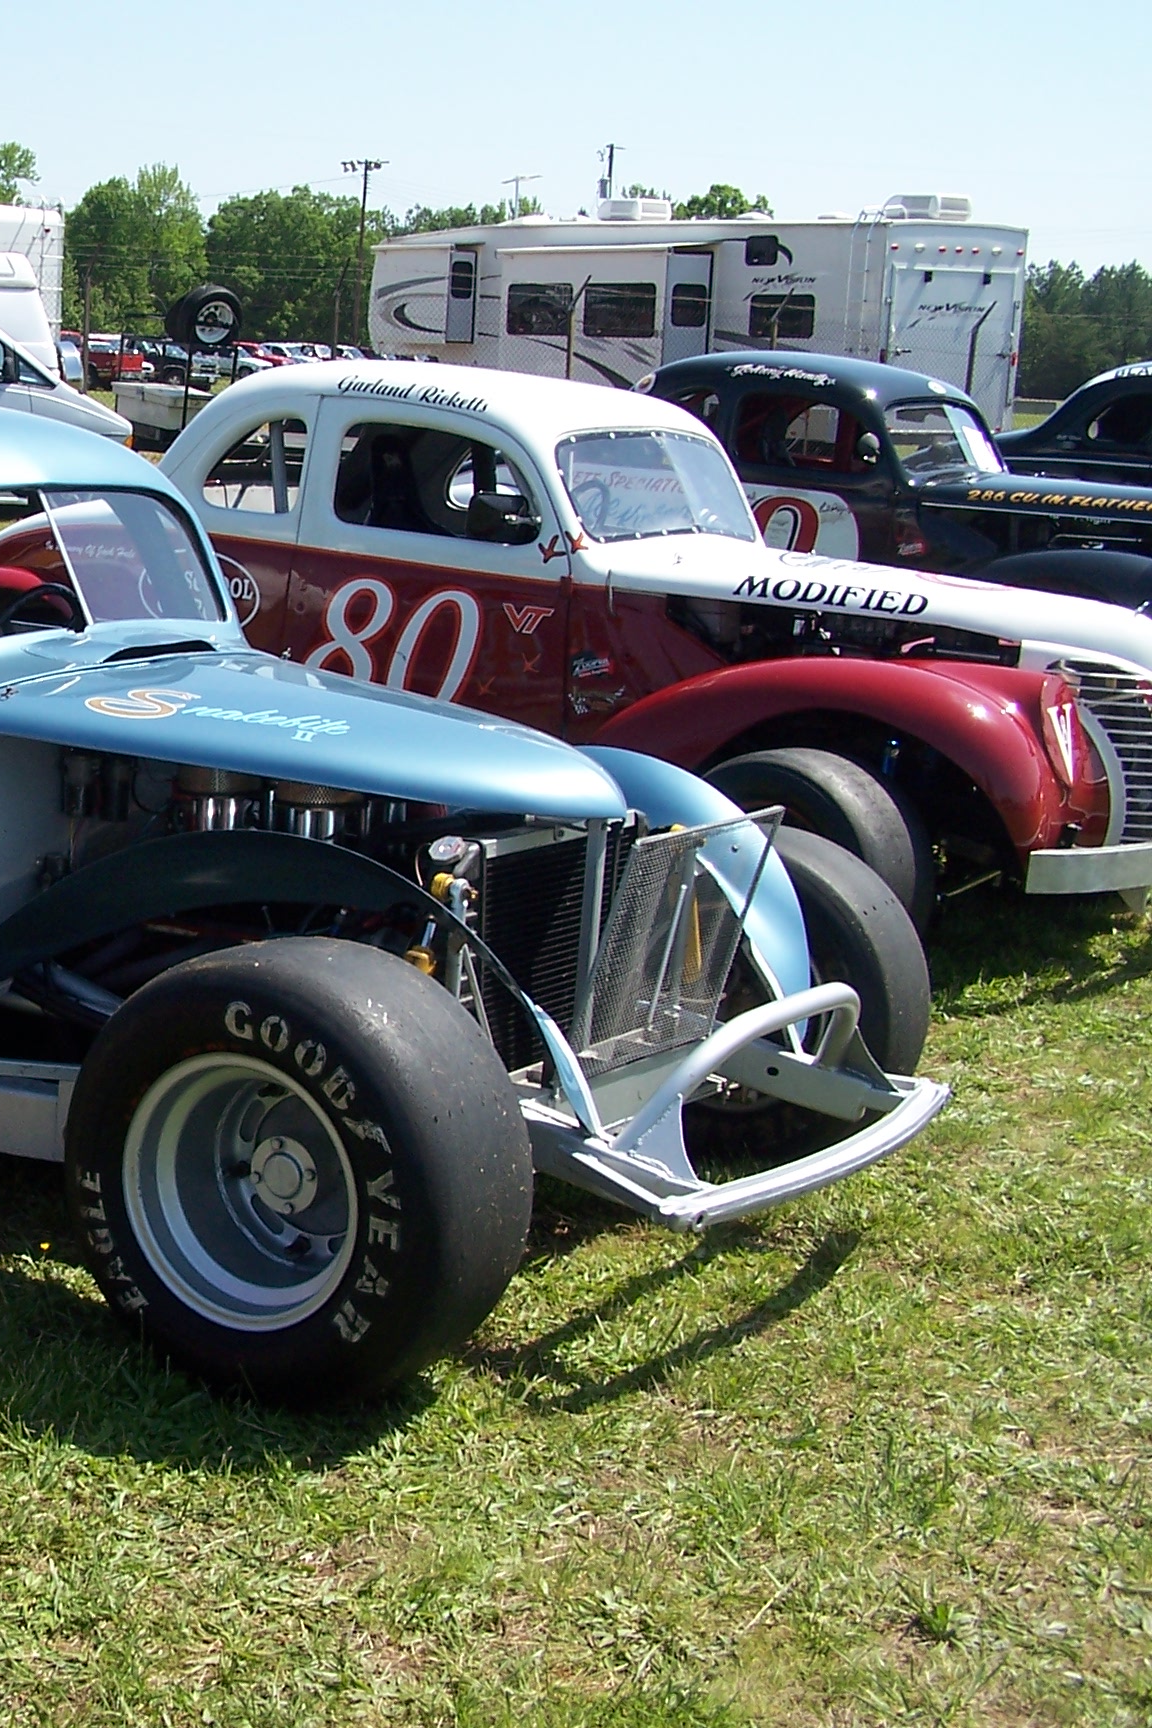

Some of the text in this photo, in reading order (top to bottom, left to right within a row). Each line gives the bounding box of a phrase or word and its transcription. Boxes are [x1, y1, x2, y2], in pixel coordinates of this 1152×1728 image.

[337, 375, 489, 413] Garland Ricketts
[967, 489, 1006, 502] 286
[1009, 492, 1038, 504] CU.
[1041, 494, 1067, 505] IN.
[732, 575, 929, 615] MODIFIED
[502, 602, 555, 634] VT
[302, 575, 484, 702] 80
[84, 688, 350, 735] Snakebite
[291, 729, 317, 743] II
[224, 1000, 401, 1344] GOODYEAR
